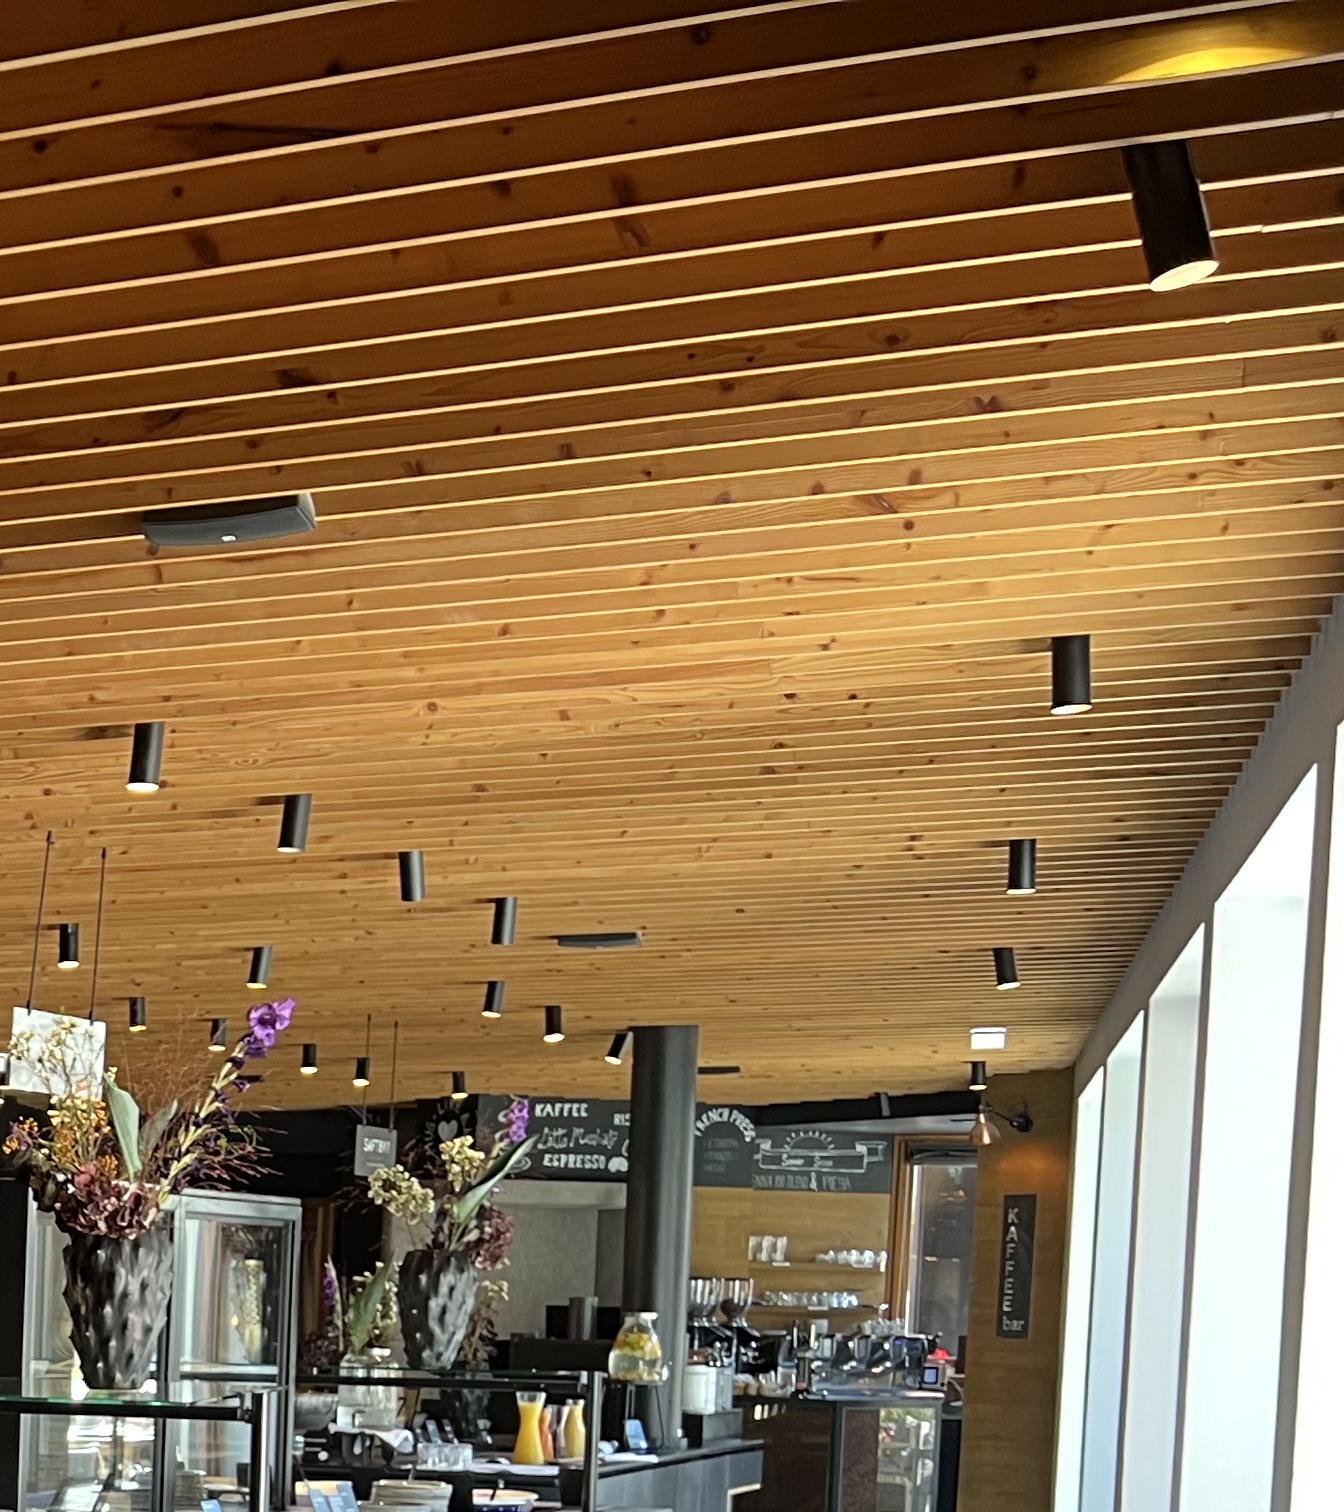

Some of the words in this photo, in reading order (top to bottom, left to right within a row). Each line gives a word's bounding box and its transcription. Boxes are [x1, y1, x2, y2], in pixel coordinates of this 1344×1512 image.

[534, 1102, 588, 1117] KAFFEE
[542, 1153, 606, 1169] ESPRESSO
[1002, 1208, 1019, 1312] KAFFEE
[1002, 1315, 1025, 1331] bar
